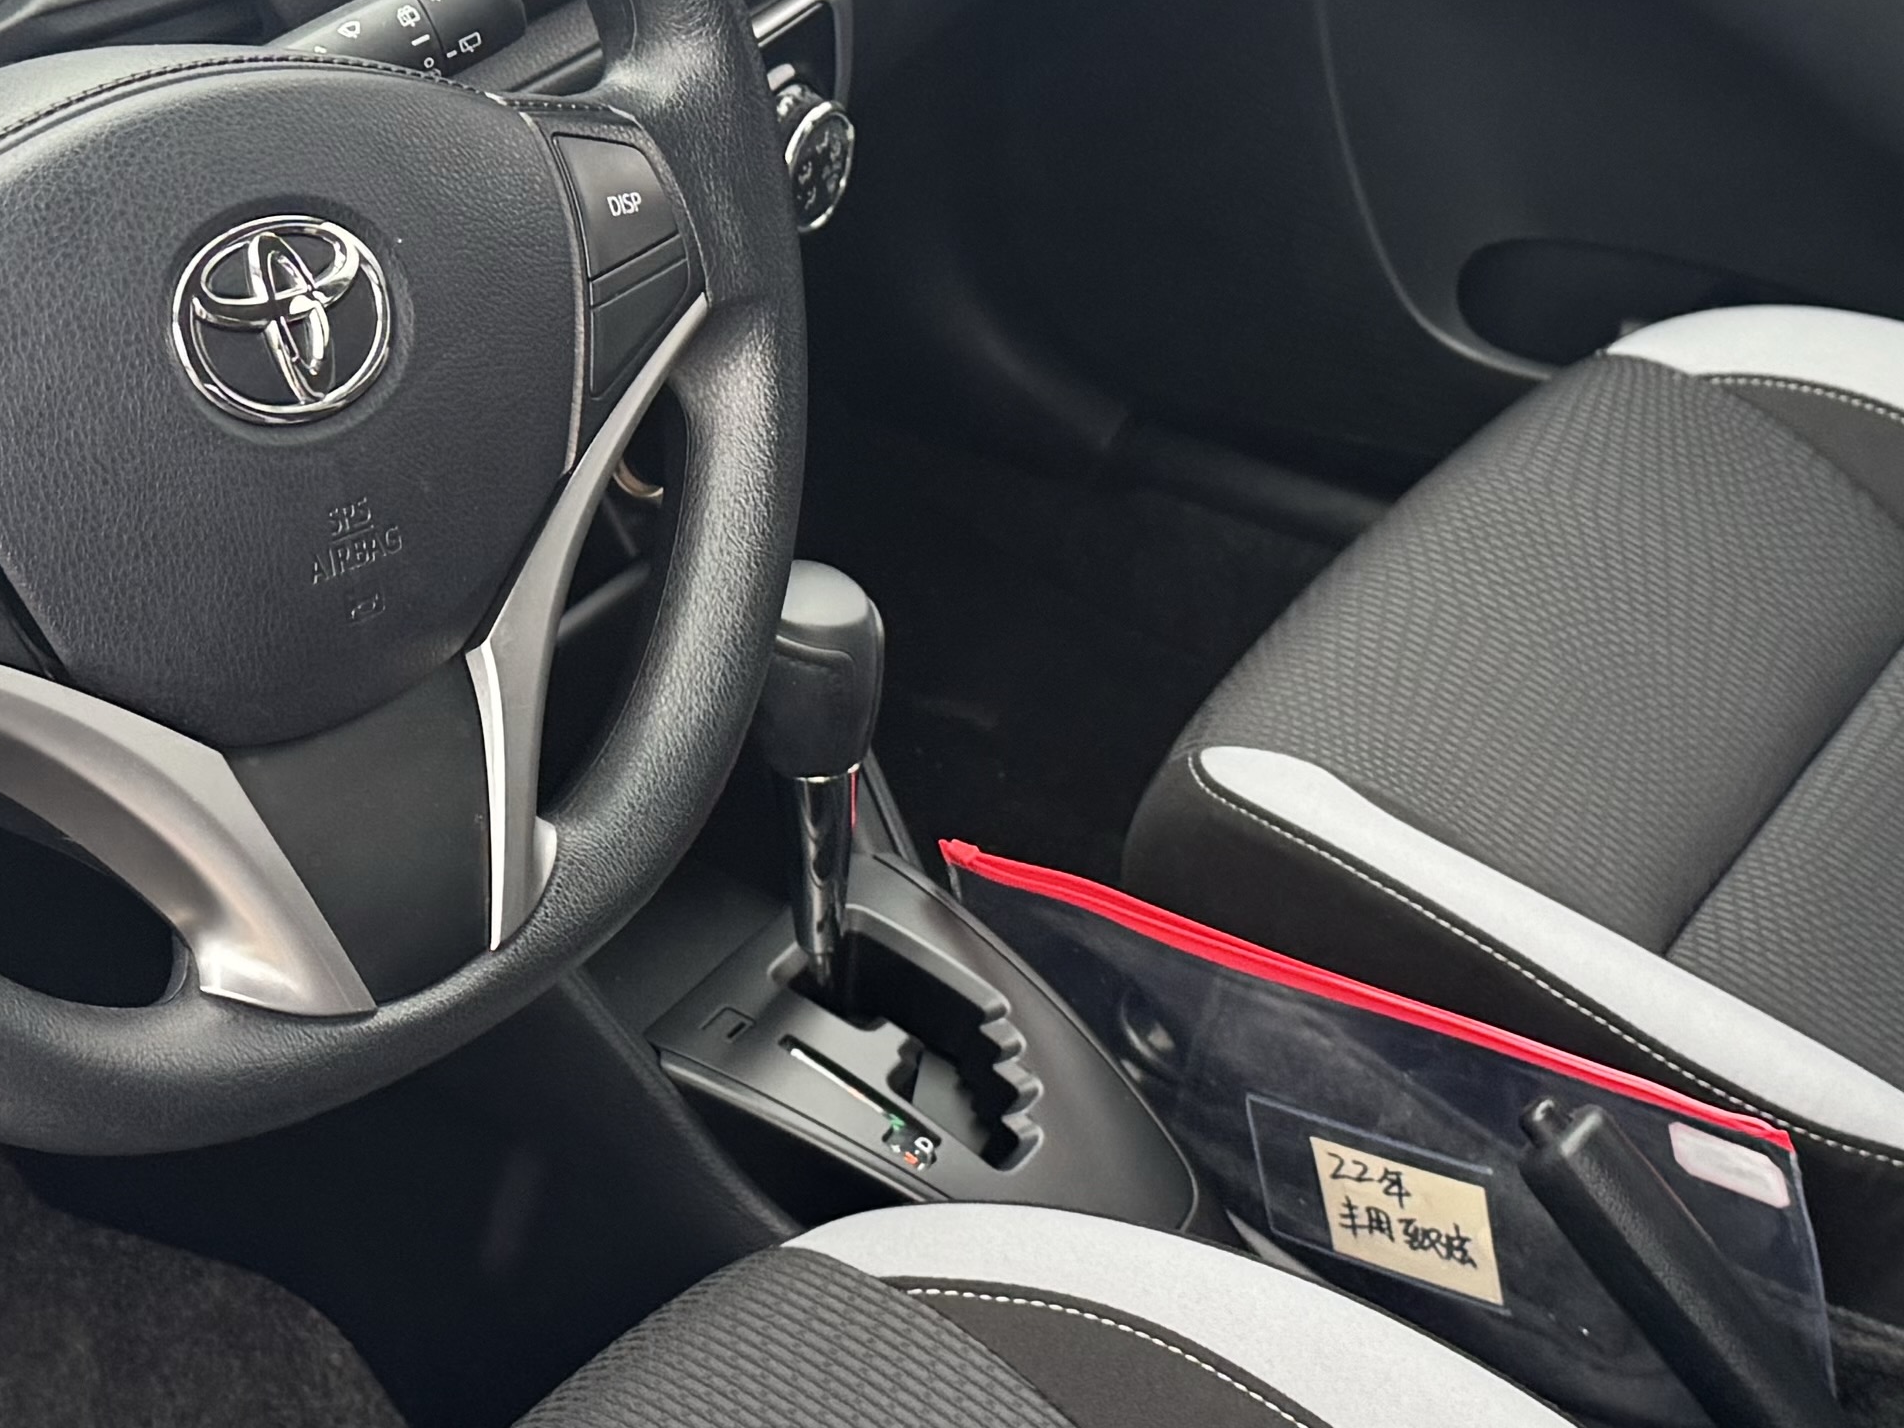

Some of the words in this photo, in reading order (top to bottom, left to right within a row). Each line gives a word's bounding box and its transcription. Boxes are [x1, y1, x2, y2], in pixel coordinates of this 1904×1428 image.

[607, 192, 642, 216] DISP
[312, 526, 403, 585] AIRBAG
[913, 1136, 934, 1154] D
[1327, 1151, 1411, 1209] 22年
